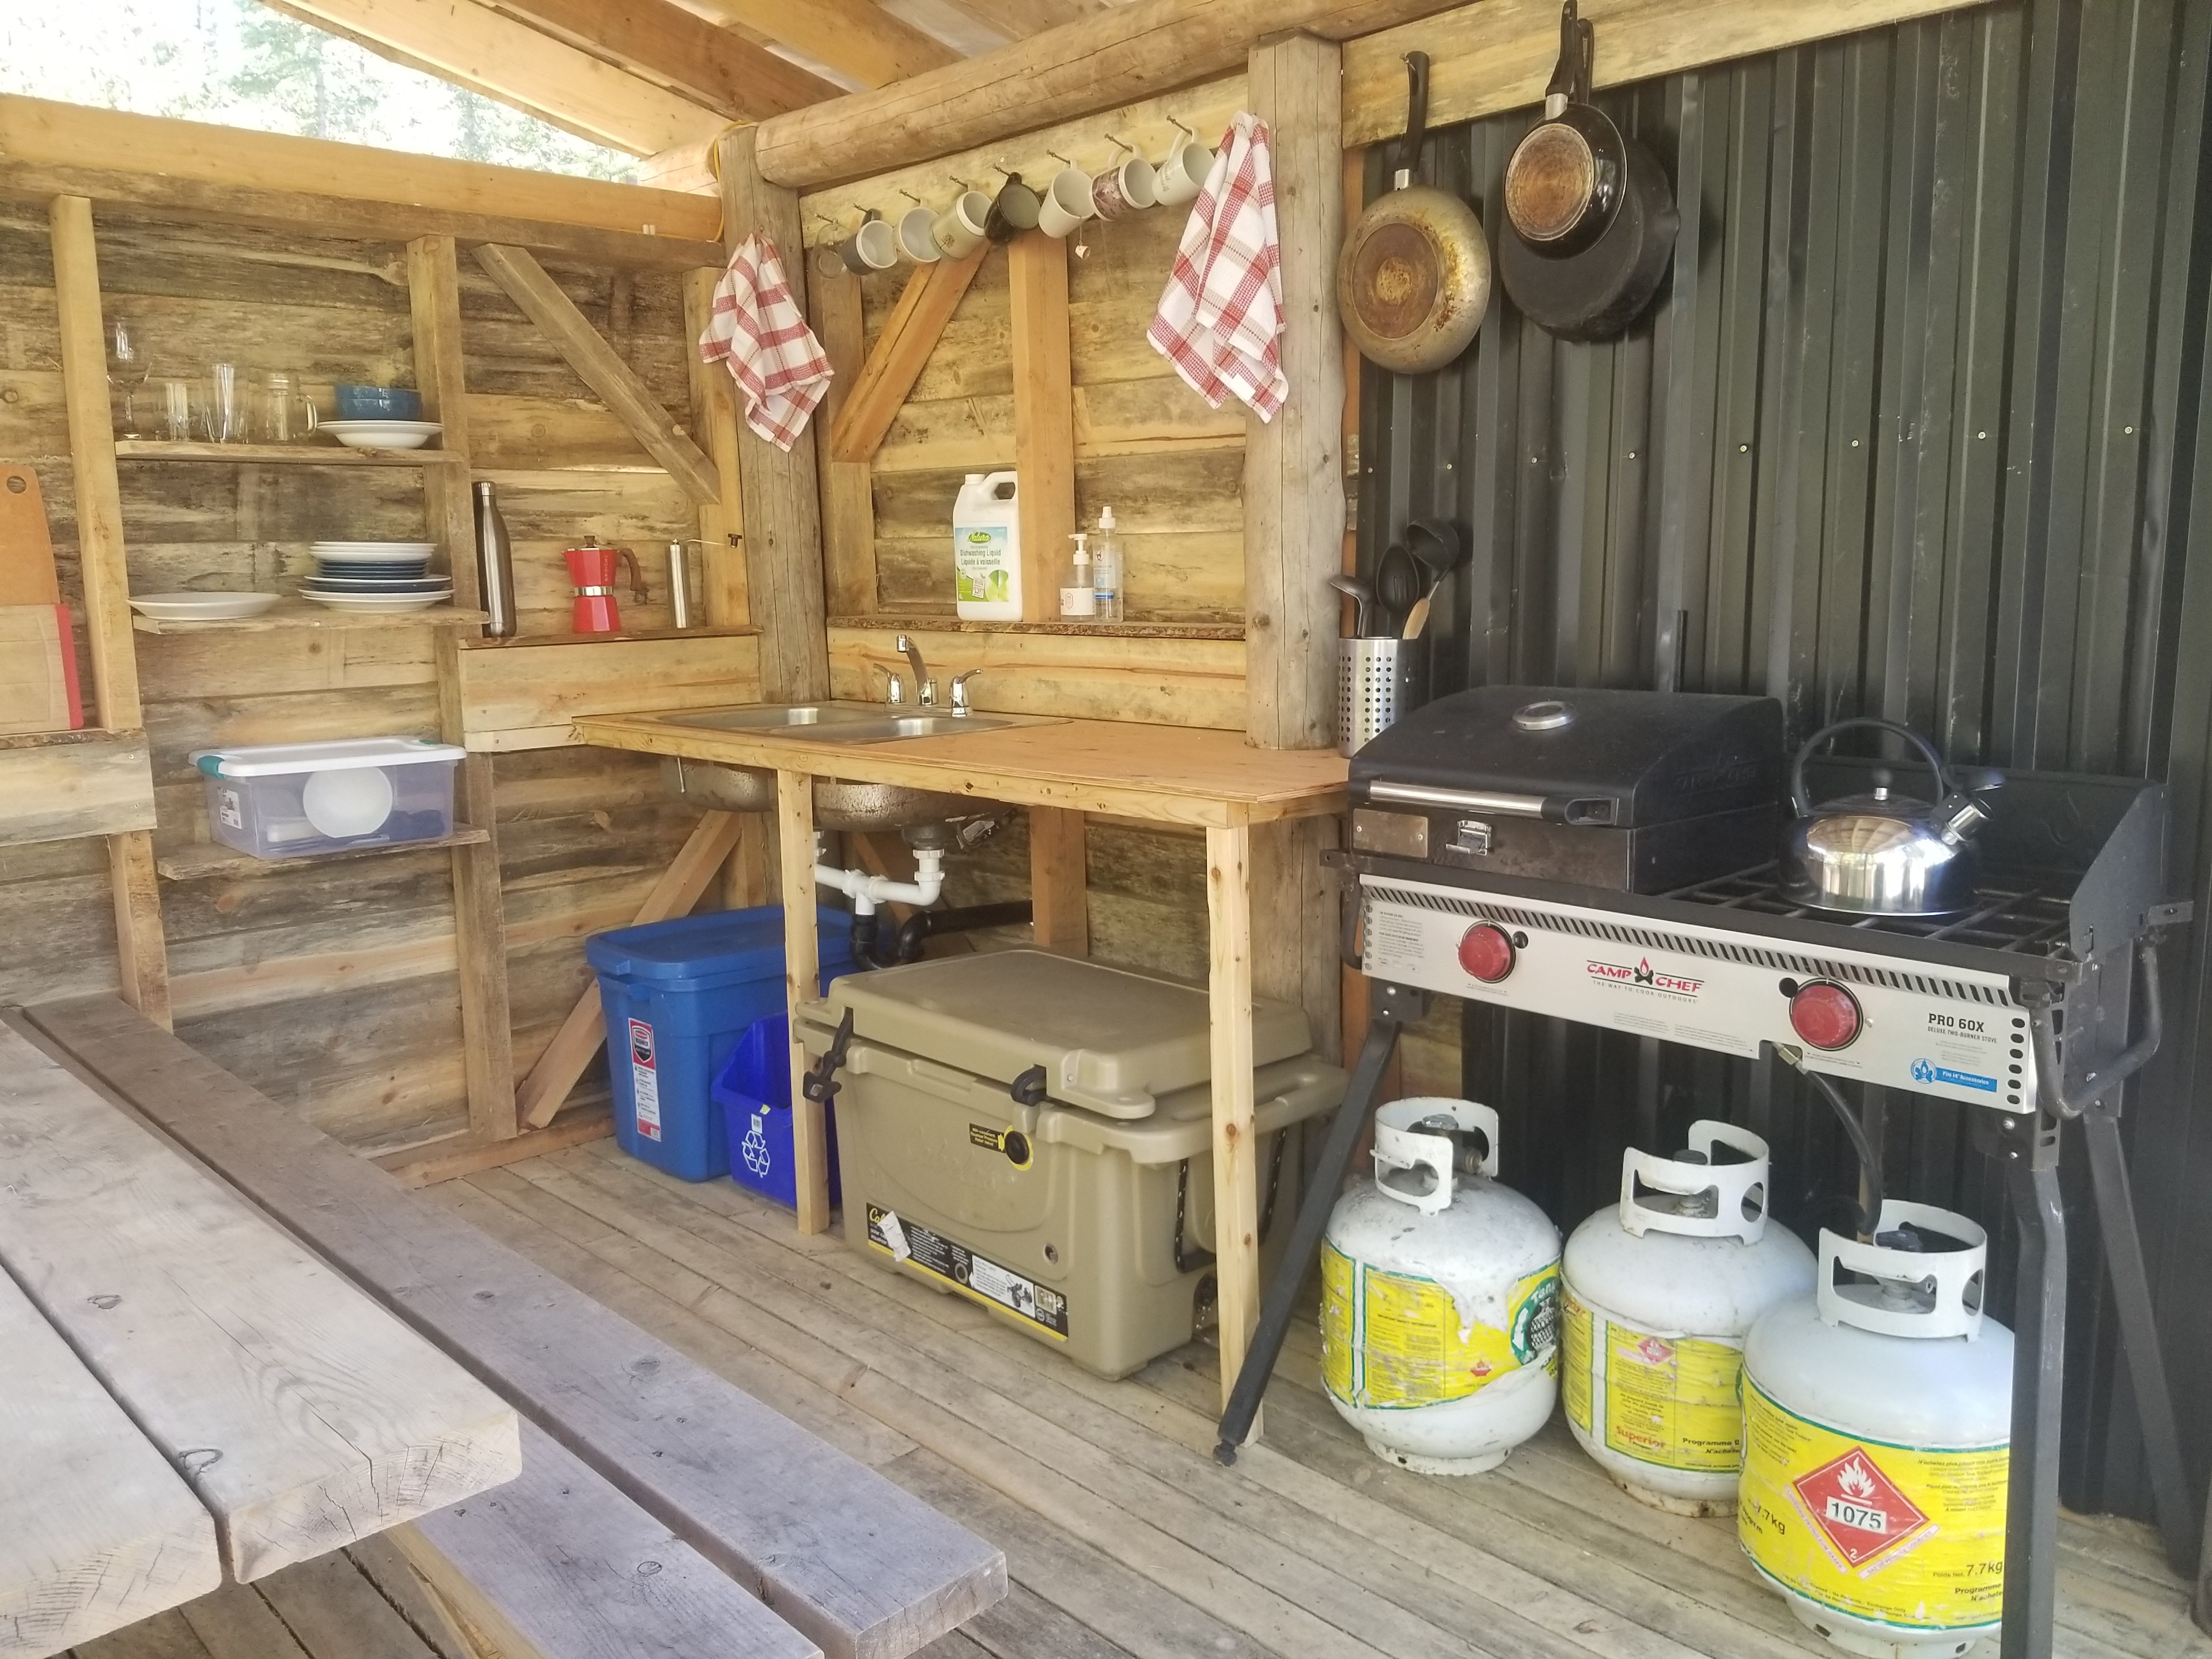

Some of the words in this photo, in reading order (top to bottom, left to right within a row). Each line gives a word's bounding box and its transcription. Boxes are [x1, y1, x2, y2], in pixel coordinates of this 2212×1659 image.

[967, 531, 990, 542] Natura
[960, 549, 986, 558] Dishwashing
[986, 549, 1001, 558] Liquid
[1586, 963, 1631, 979] CAMP
[1655, 976, 1702, 992] CHEF
[1657, 993, 1697, 1004] OUTDOORS
[1928, 1013, 1955, 1027] PRO
[1959, 1018, 1984, 1032] 60X
[1927, 1027, 1946, 1035] DELUXE
[1982, 1036, 1998, 1044] STOVE
[1616, 1425, 1666, 1449] Superior
[1683, 1437, 1731, 1447] Programme
[1832, 1502, 1881, 1530] 1075
[1850, 1548, 1857, 1560] 2
[1966, 1560, 2003, 1577] 7.7kg
[1955, 1583, 2002, 1594] Programme
